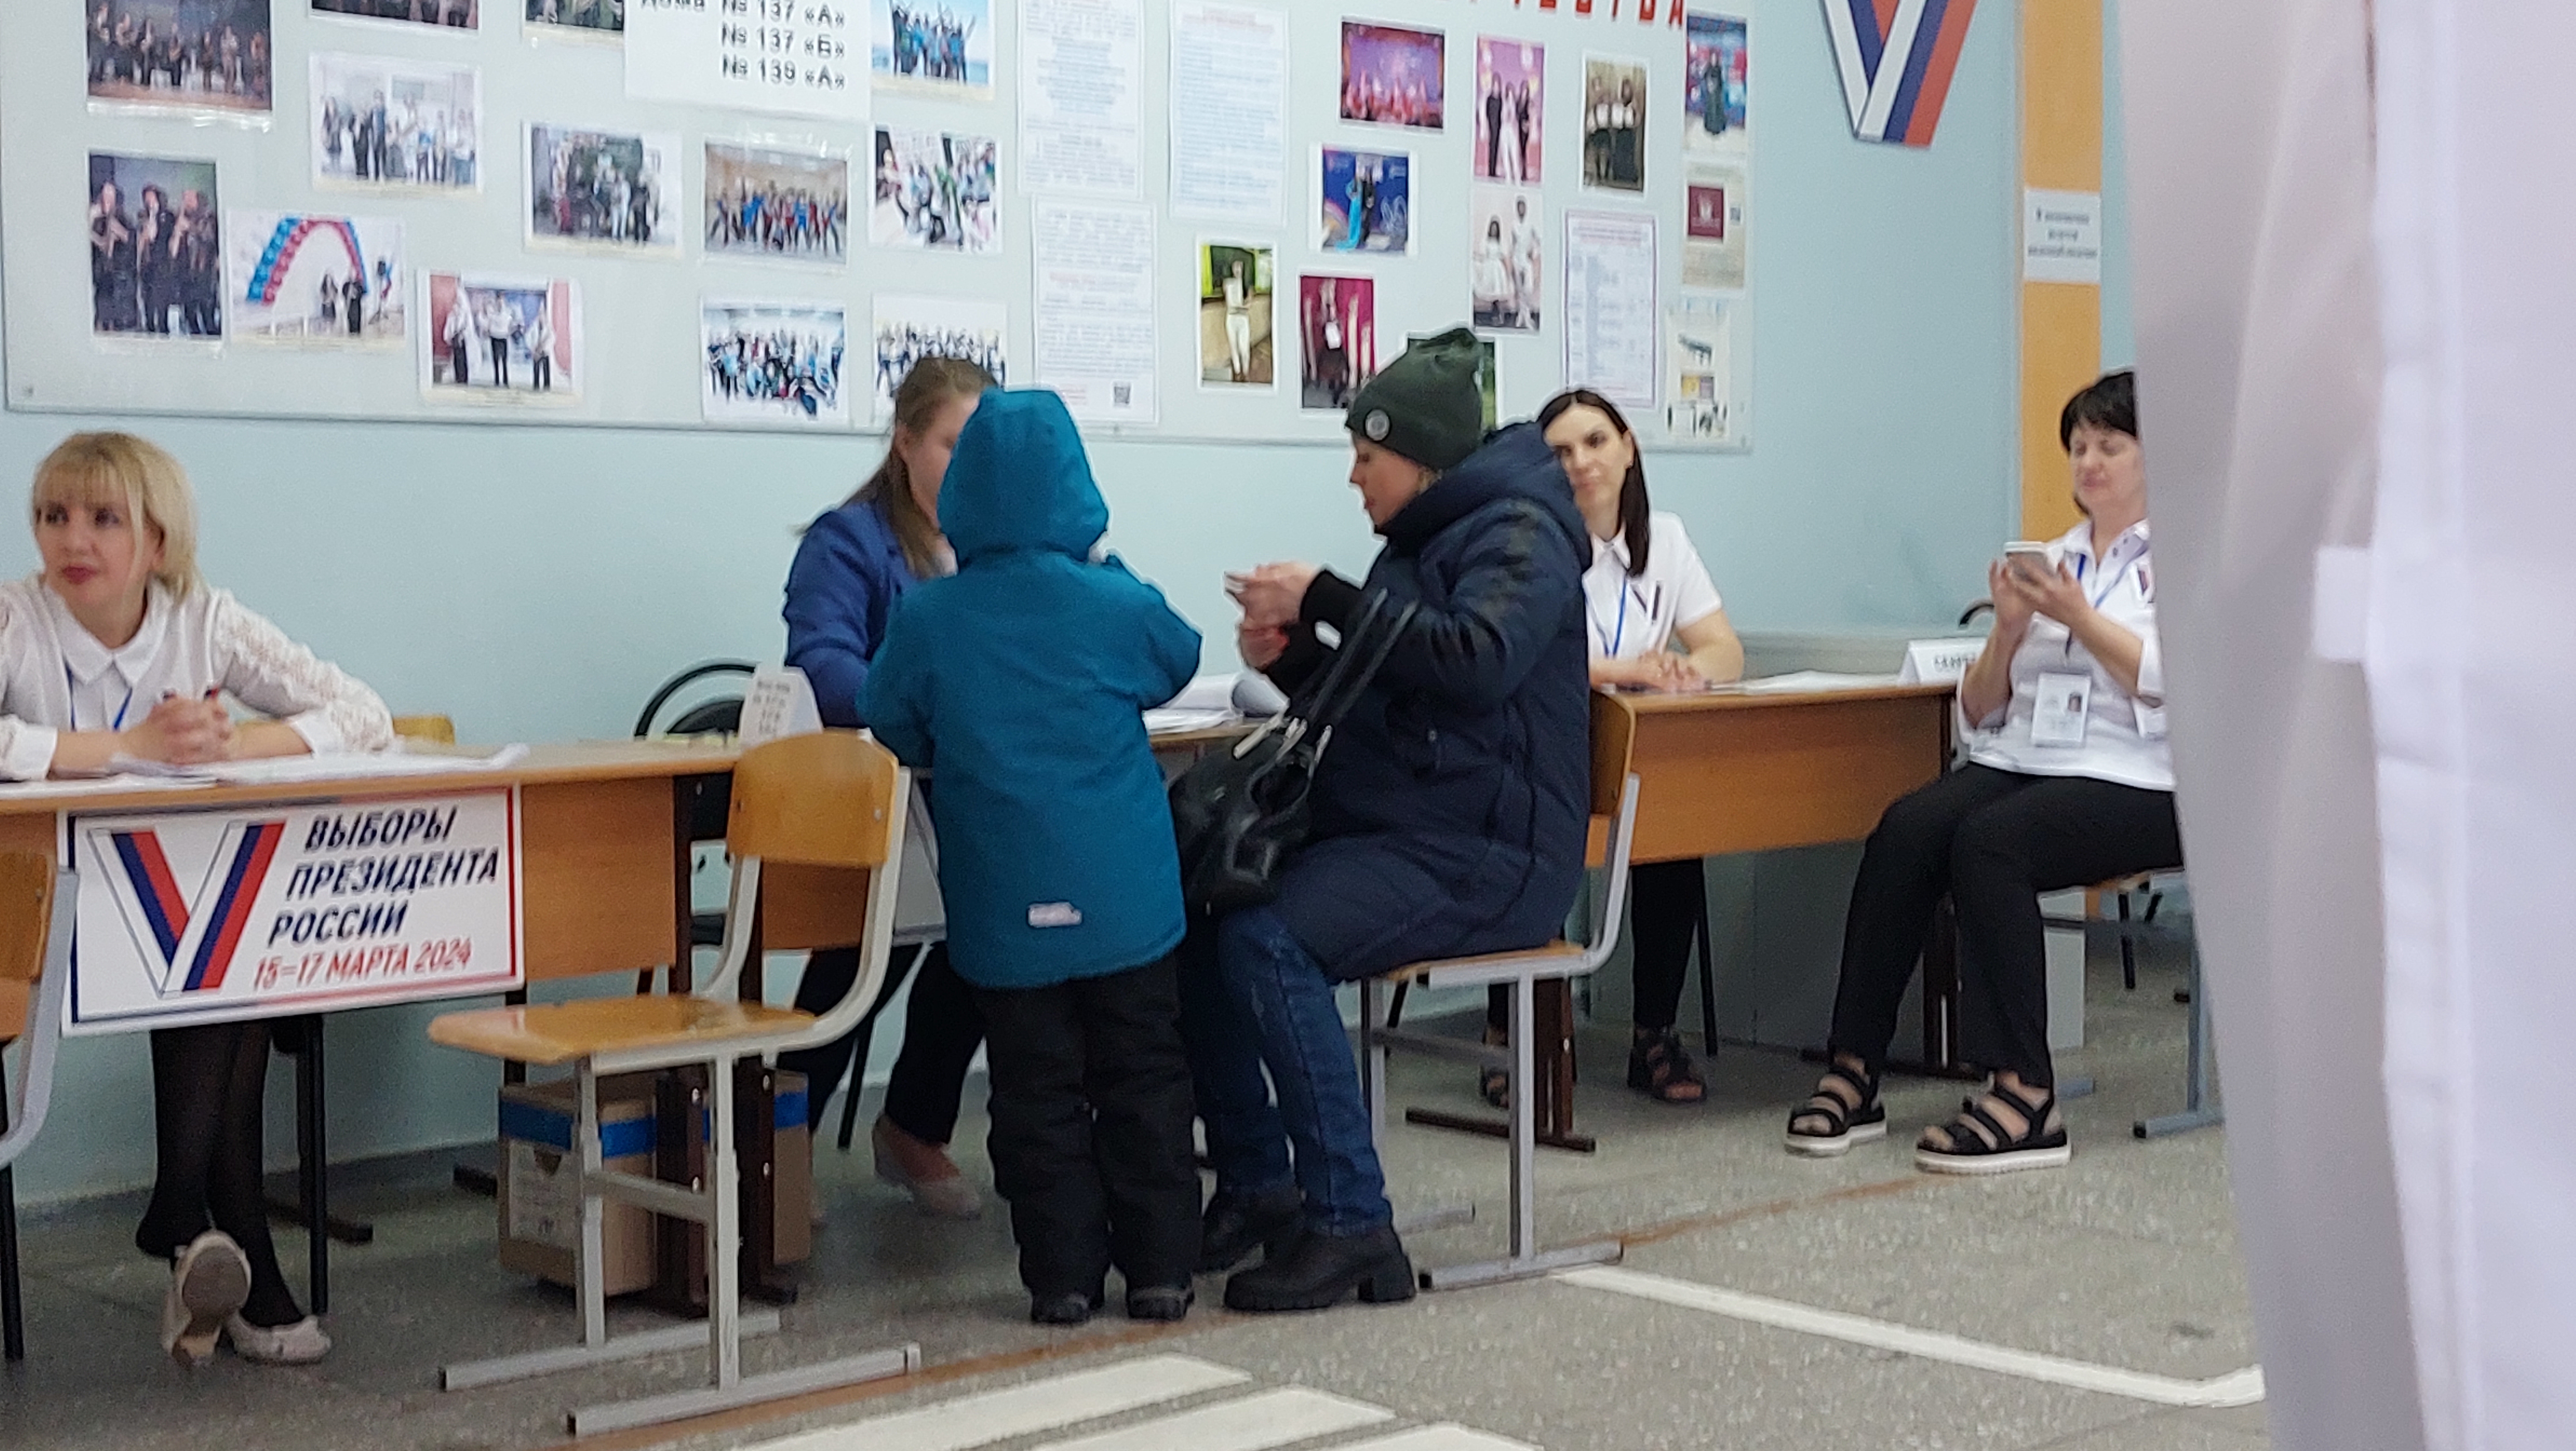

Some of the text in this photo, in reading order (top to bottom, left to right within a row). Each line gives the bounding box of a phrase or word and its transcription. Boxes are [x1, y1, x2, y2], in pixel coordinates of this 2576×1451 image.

[757, 0, 794, 22] 137
[722, 22, 748, 48] №
[757, 26, 794, 53] 137
[722, 55, 748, 80] №
[305, 805, 458, 851] ВЫБОРЫ
[286, 846, 499, 900] ПРЕЗИДЕНТА
[268, 899, 409, 947] РОССИИ
[325, 942, 409, 983] МАРТА
[413, 937, 472, 973] 2024
